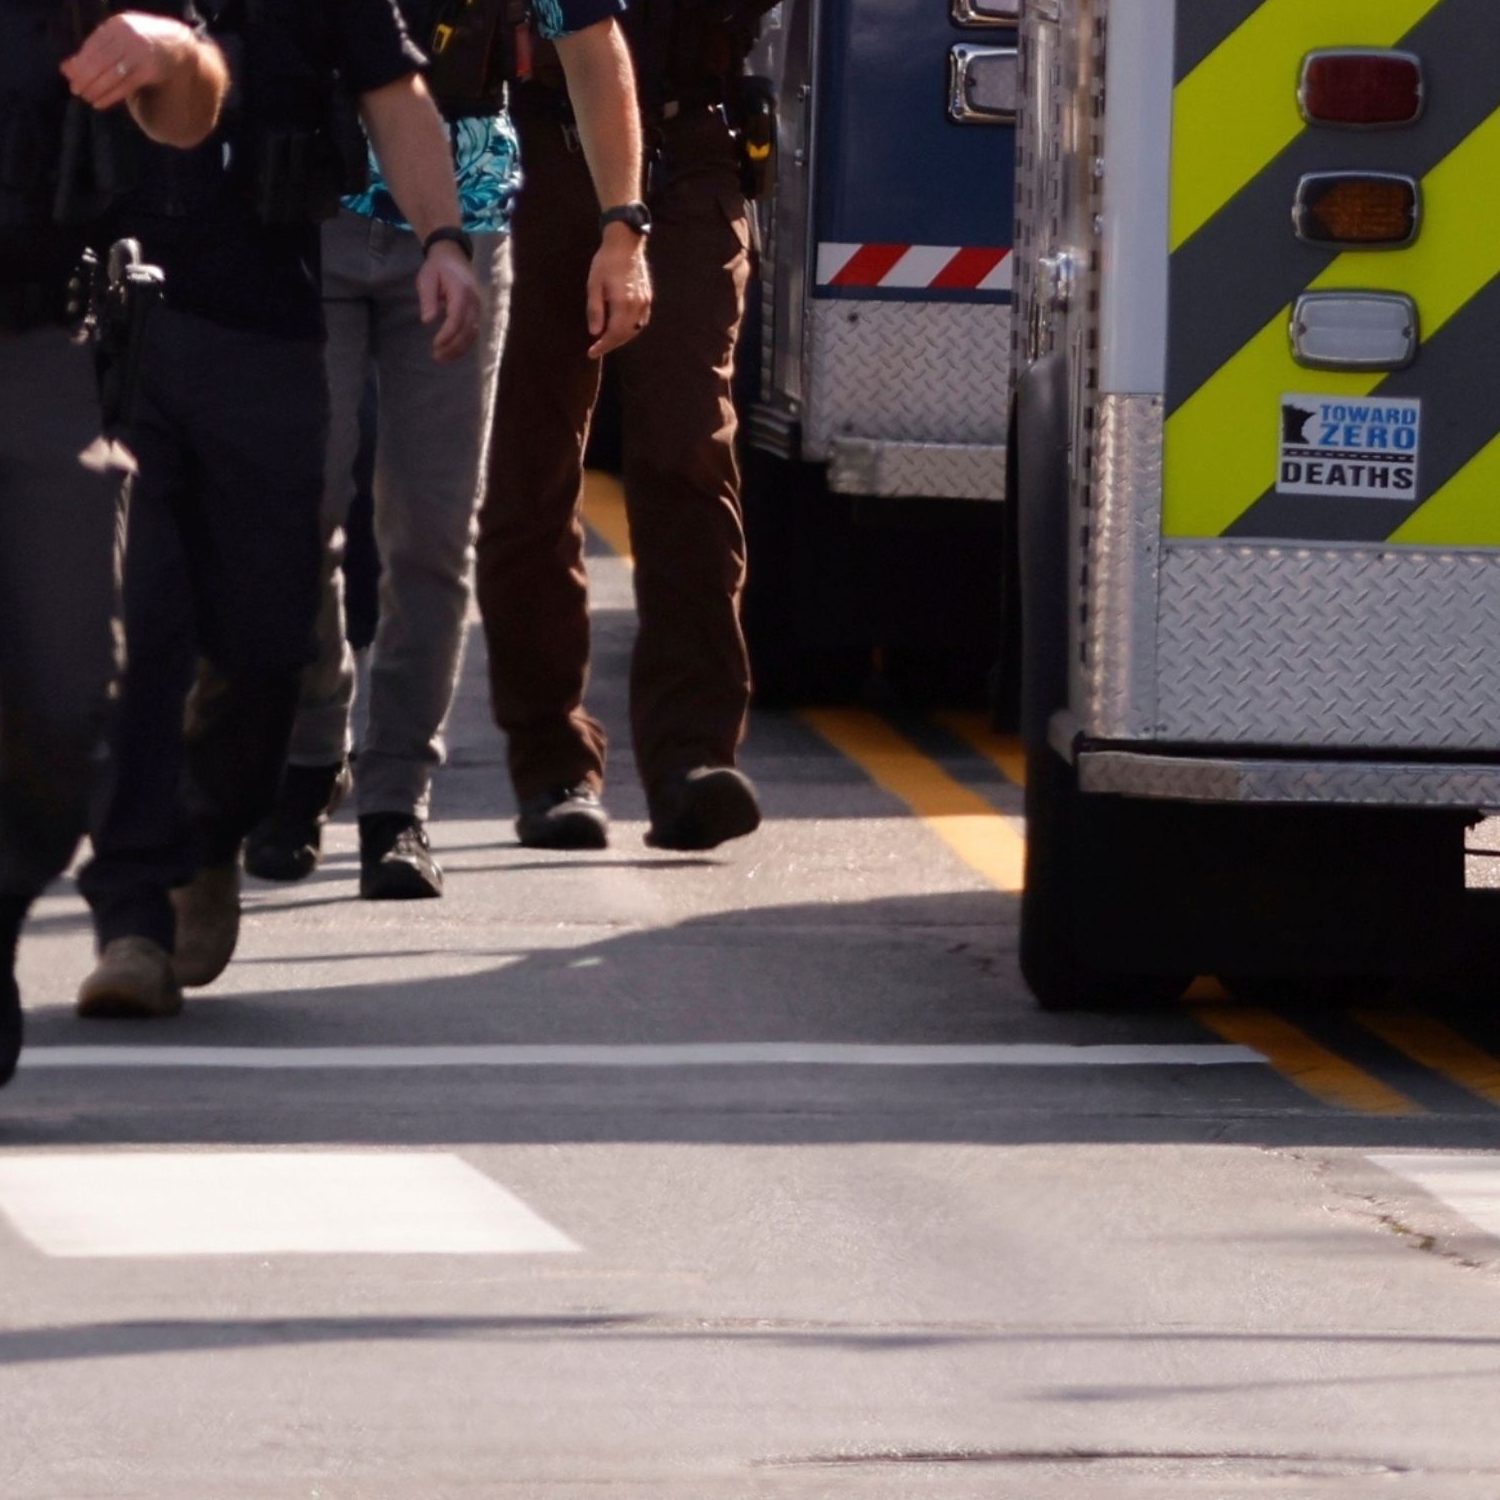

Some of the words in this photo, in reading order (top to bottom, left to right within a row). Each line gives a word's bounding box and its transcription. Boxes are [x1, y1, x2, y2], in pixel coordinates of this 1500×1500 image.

[1319, 404, 1417, 426] TOWARD
[1317, 423, 1416, 450] ZERO
[1279, 461, 1414, 490] DEATHS
